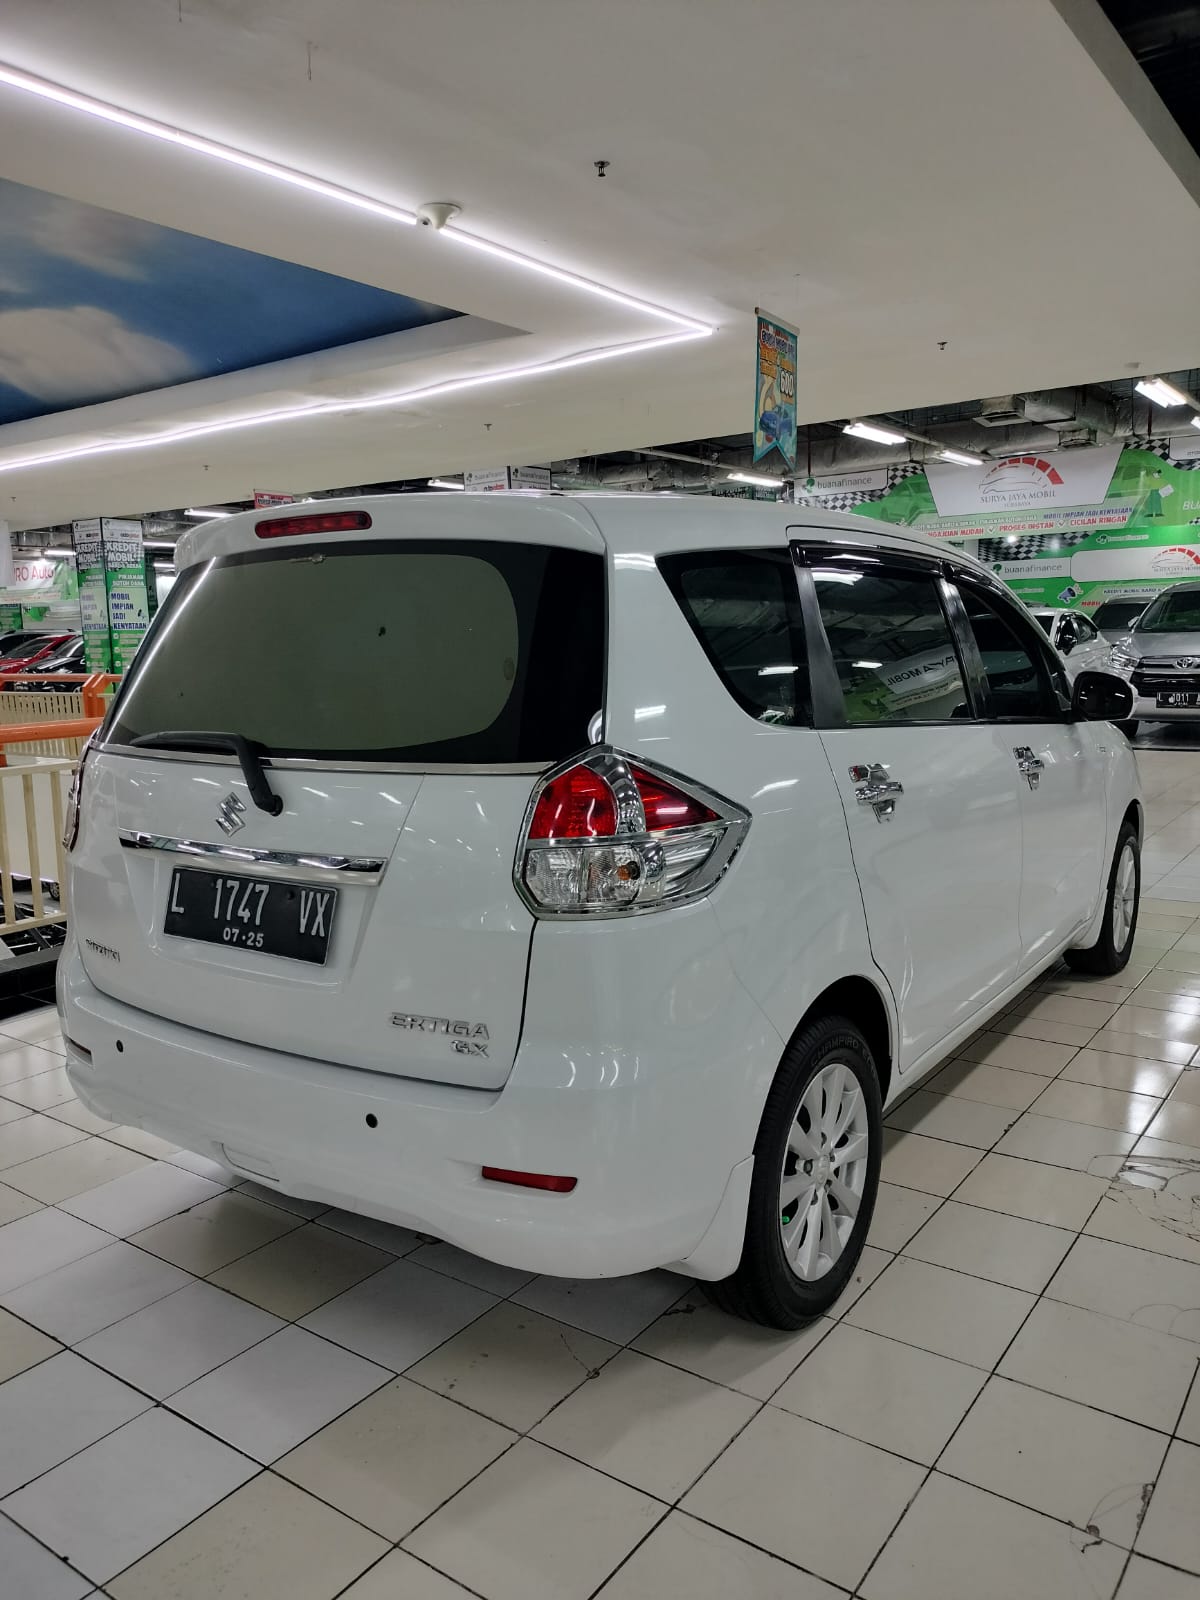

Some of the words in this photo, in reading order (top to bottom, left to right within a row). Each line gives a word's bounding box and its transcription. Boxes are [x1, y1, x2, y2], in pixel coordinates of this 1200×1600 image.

[780, 371, 794, 394] 600
[817, 477, 872, 489] buanafinance
[980, 495, 1006, 503] SURYA
[1009, 493, 1027, 501] JAYA
[1029, 490, 1056, 498] MOBIL
[1062, 511, 1084, 519] IMPIAN
[960, 527, 984, 536] MUDAH
[1000, 524, 1026, 532] PROSES
[1028, 522, 1054, 530] INSTAN
[1070, 517, 1096, 526] CICILAN
[1098, 515, 1127, 524] RINGAN
[106, 542, 137, 552] KREDIT
[108, 552, 135, 562] MOBIL
[32, 566, 54, 579] Auto
[1004, 564, 1062, 574] buanafinance
[171, 873, 184, 914] L
[214, 878, 270, 926] 1747
[300, 890, 330, 937] VX
[390, 1012, 490, 1040] ERTIGA
[450, 1039, 490, 1058] GX
